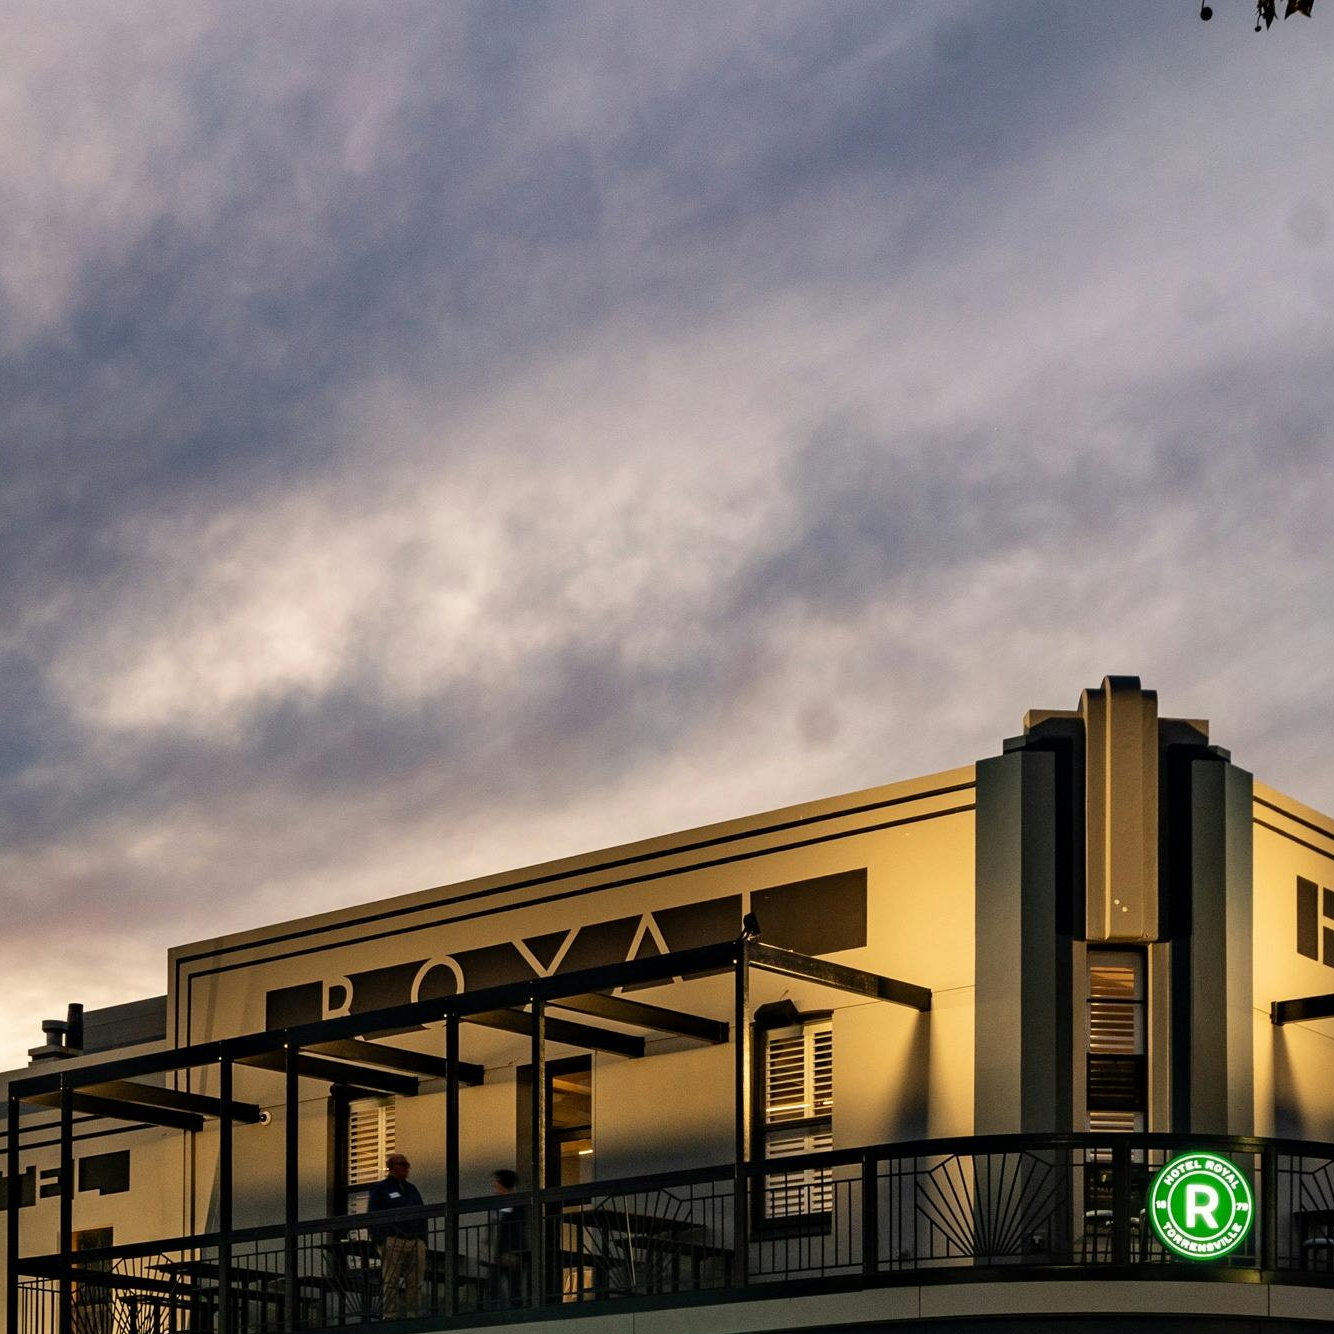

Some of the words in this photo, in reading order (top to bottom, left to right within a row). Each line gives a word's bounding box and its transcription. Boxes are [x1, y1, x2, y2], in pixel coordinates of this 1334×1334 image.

[1164, 1160, 1202, 1186] HOTEL
[1205, 1160, 1240, 1189] ROYAL
[1186, 1183, 1219, 1229] R
[1163, 1221, 1242, 1253] TORRENSVILLE
